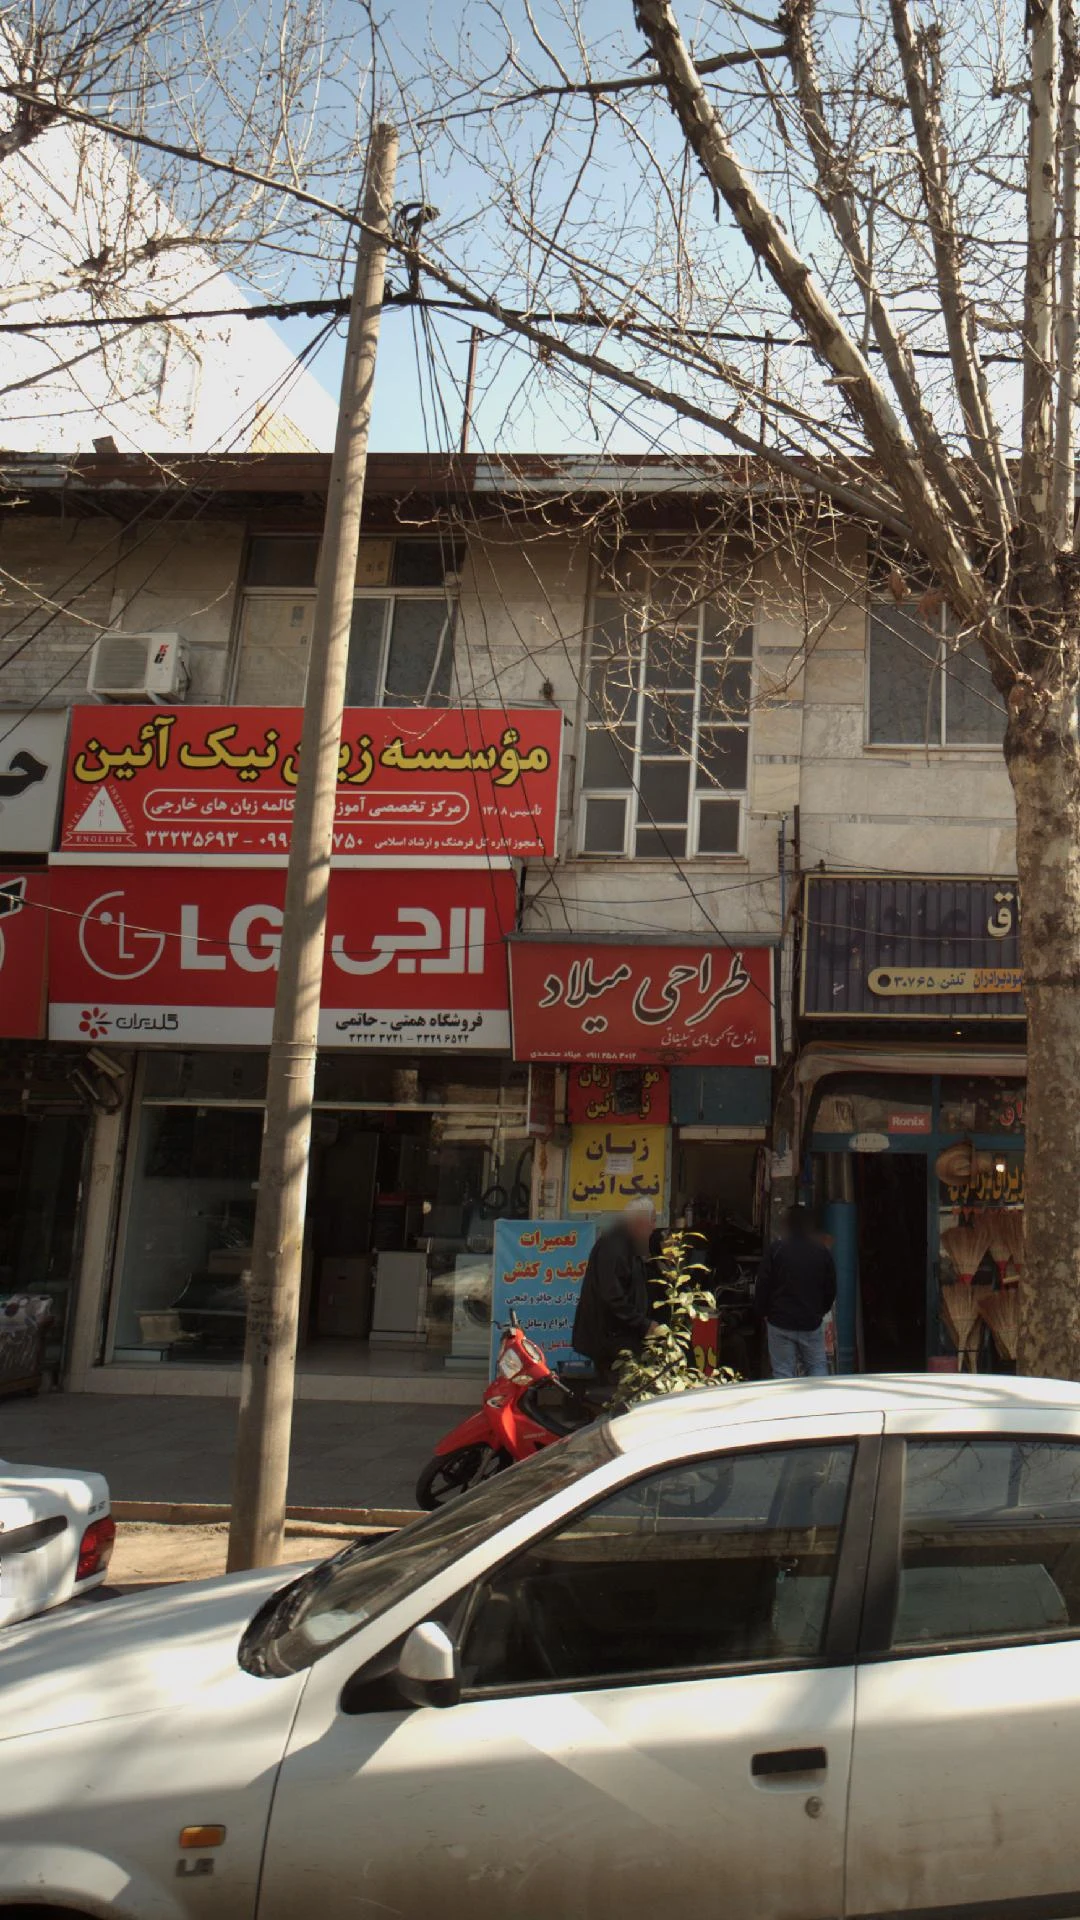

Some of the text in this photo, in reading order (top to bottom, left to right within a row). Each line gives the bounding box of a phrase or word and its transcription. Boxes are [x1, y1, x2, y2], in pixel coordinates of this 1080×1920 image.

[73, 714, 177, 783] آئین
[178, 724, 280, 782] نیک
[379, 727, 550, 787] مؤسسه
[150, 797, 197, 816] خارجی
[200, 798, 227, 815] های
[230, 798, 258, 815] زبان
[335, 796, 461, 817] مرکز تخصصی آموز
[76, 835, 122, 843] ENGLISH
[374, 837, 407, 849] اسلامی
[408, 837, 433, 849] ارشاد
[434, 841, 440, 849] و
[441, 838, 474, 849] فرهنگ
[513, 839, 535, 850] مجوز
[180, 903, 283, 973] LG
[940, 972, 966, 989] تلفن
[538, 952, 751, 1034] طراحی میلاد
[336, 1012, 483, 1032] فروشگاه همتی حاتمی
[892, 1116, 925, 1127] Ronix
[586, 1133, 649, 1160] زبان
[520, 1230, 577, 1252] تعمیرات
[503, 1261, 541, 1283] کفش
[544, 1267, 553, 1284] و
